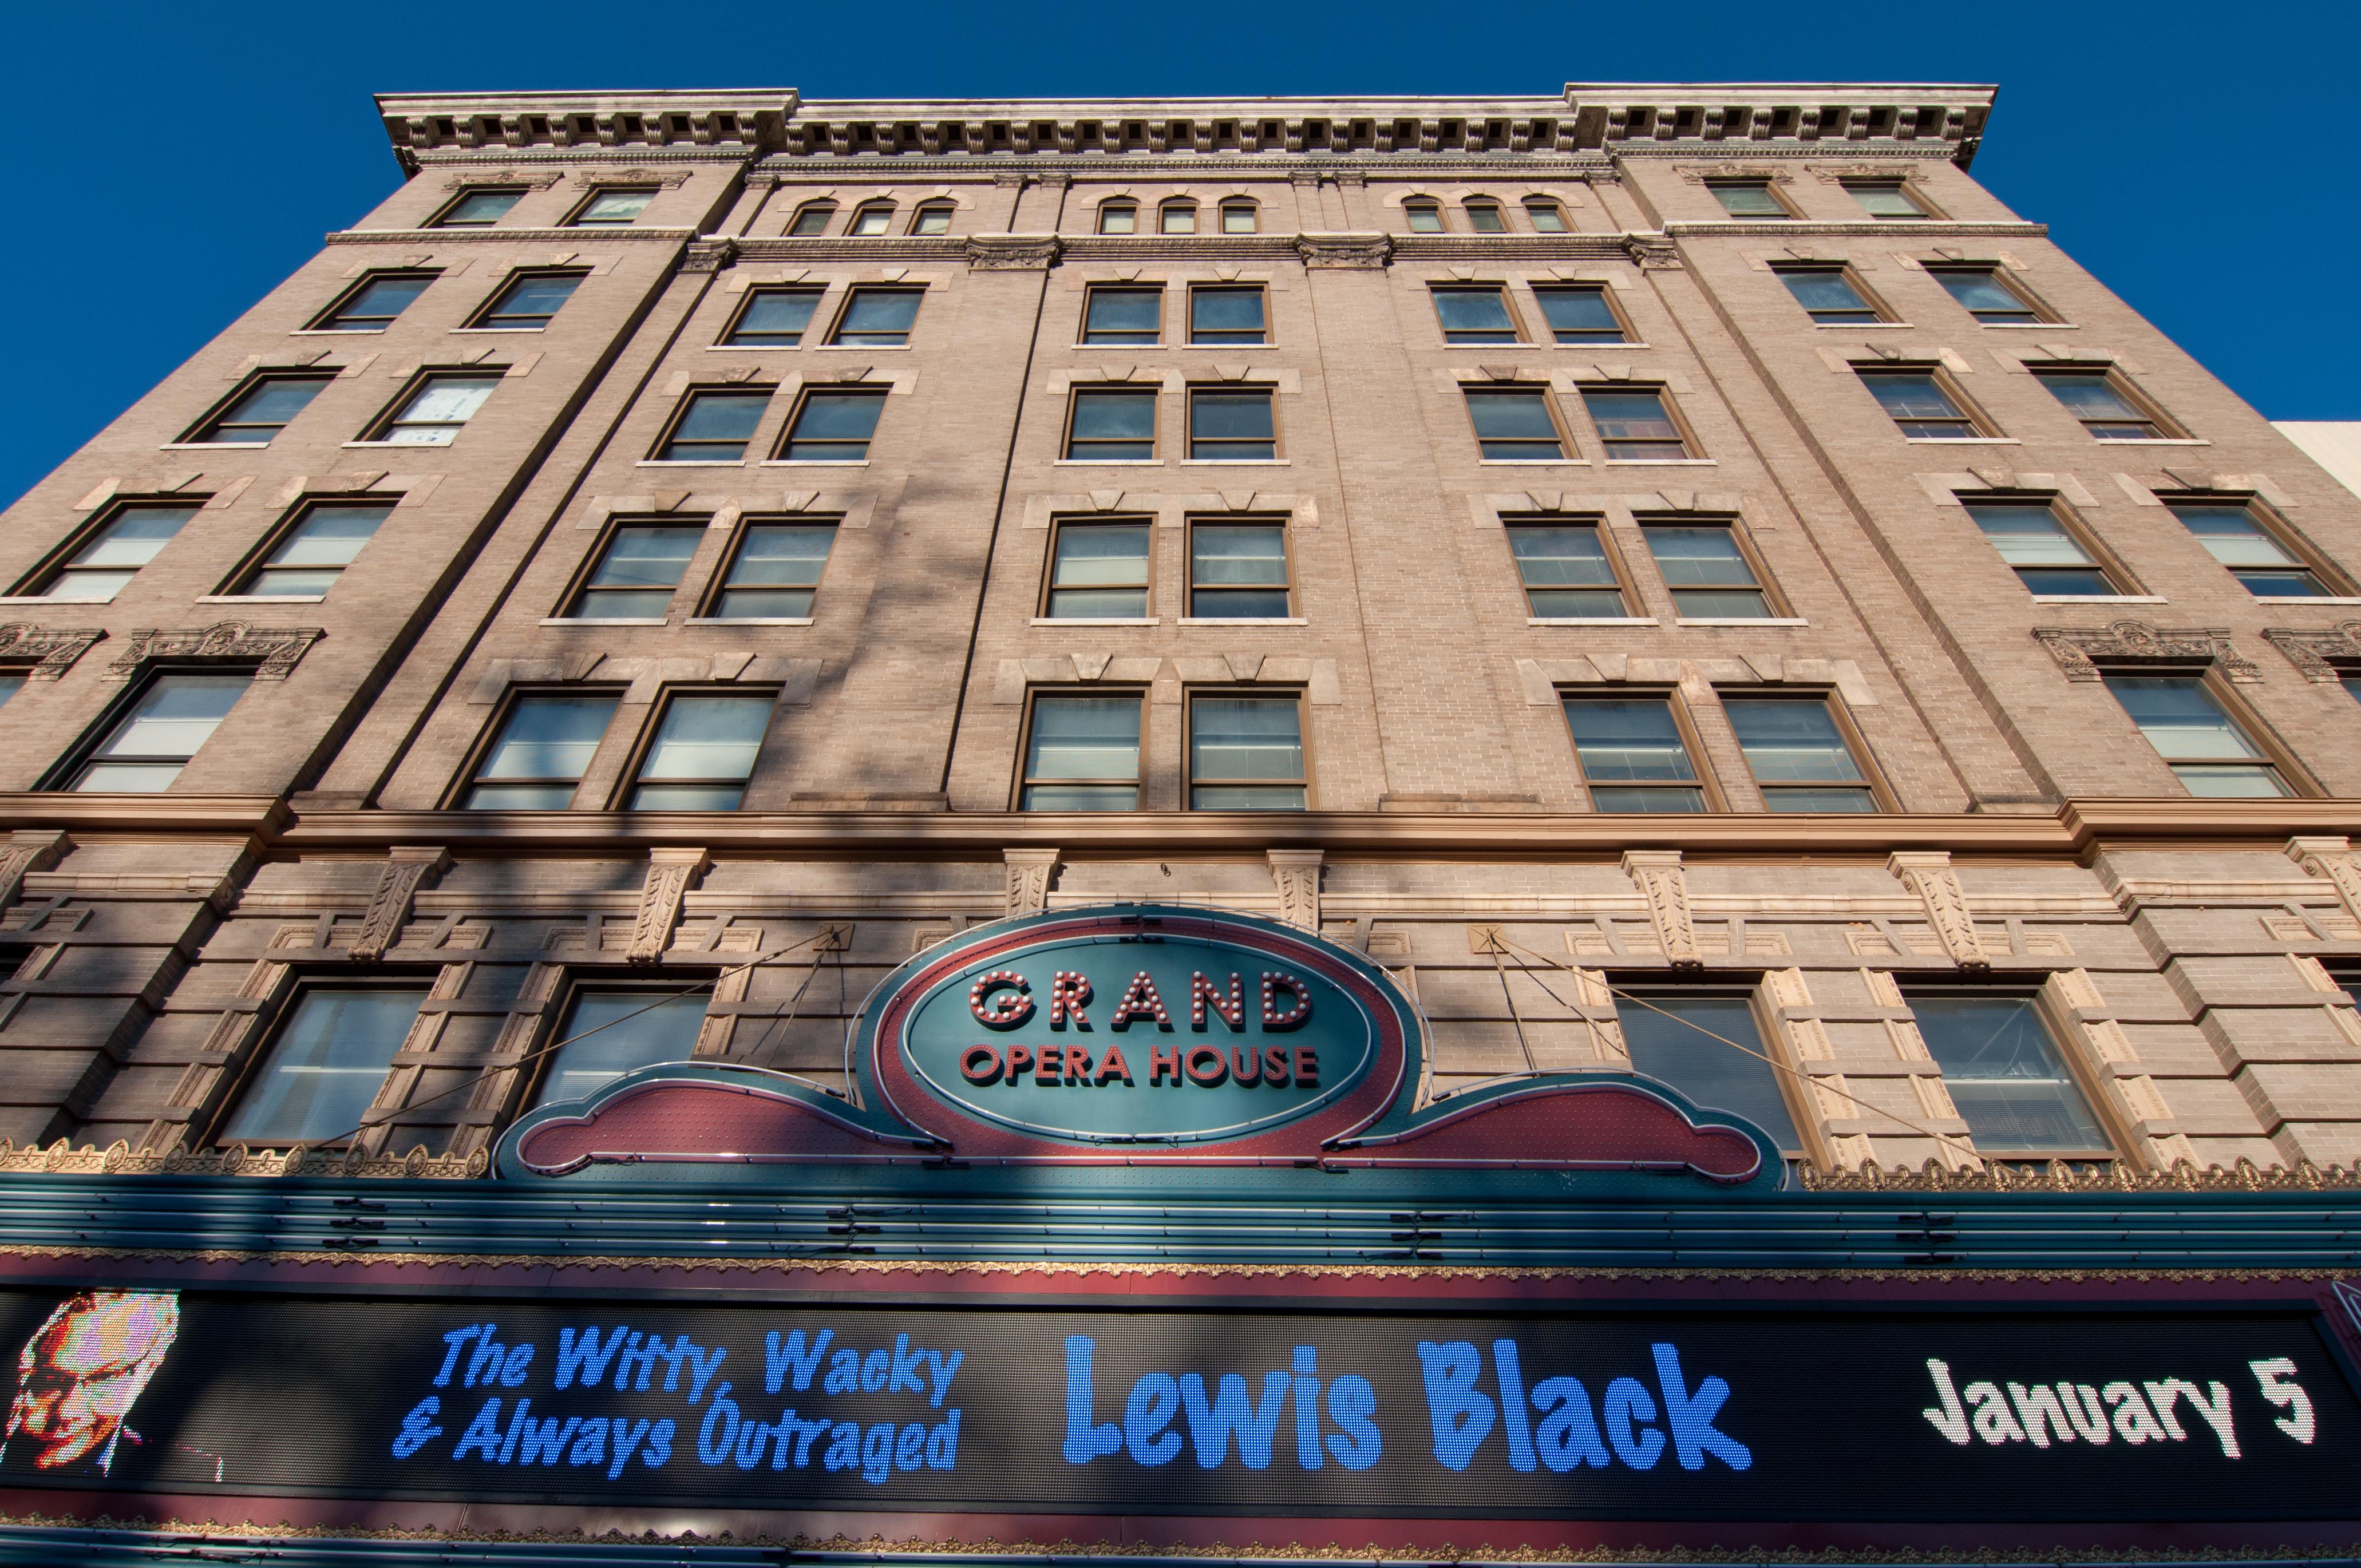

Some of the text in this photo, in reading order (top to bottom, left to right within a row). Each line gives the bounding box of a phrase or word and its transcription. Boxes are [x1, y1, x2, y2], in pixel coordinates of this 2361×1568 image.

[969, 971, 1312, 1028] GRAND
[959, 1043, 1319, 1085] OPERA HOUSE
[433, 1323, 966, 1409] The Witty, Wacky
[1061, 1333, 1753, 1473] Lewis Black
[1922, 1357, 2316, 1460] January 5
[391, 1396, 963, 1486] & Always Outraged
